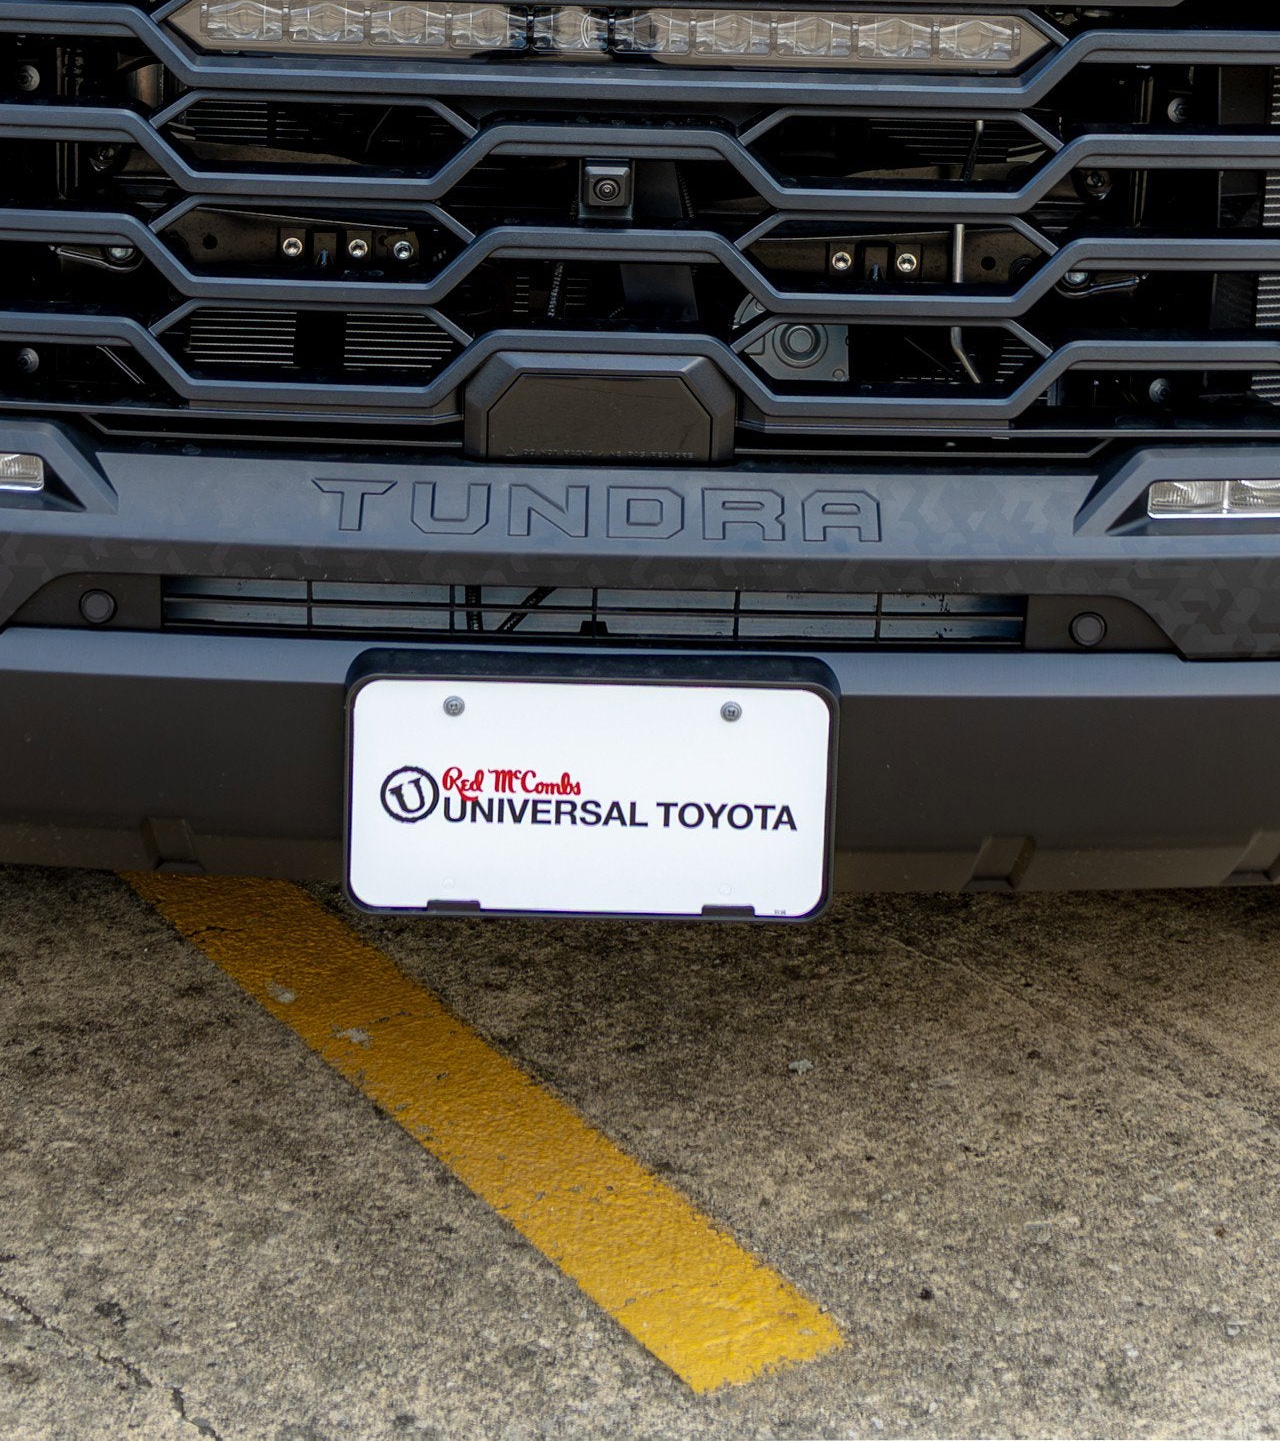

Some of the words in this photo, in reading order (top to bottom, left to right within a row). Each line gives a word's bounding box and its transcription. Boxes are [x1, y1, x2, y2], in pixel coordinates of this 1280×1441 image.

[311, 478, 882, 542] TUNDRA
[442, 766, 484, 802] Red
[488, 768, 581, 796] McCombs
[443, 796, 648, 828] UNIVERSAL
[656, 801, 798, 832] TOYOTA
